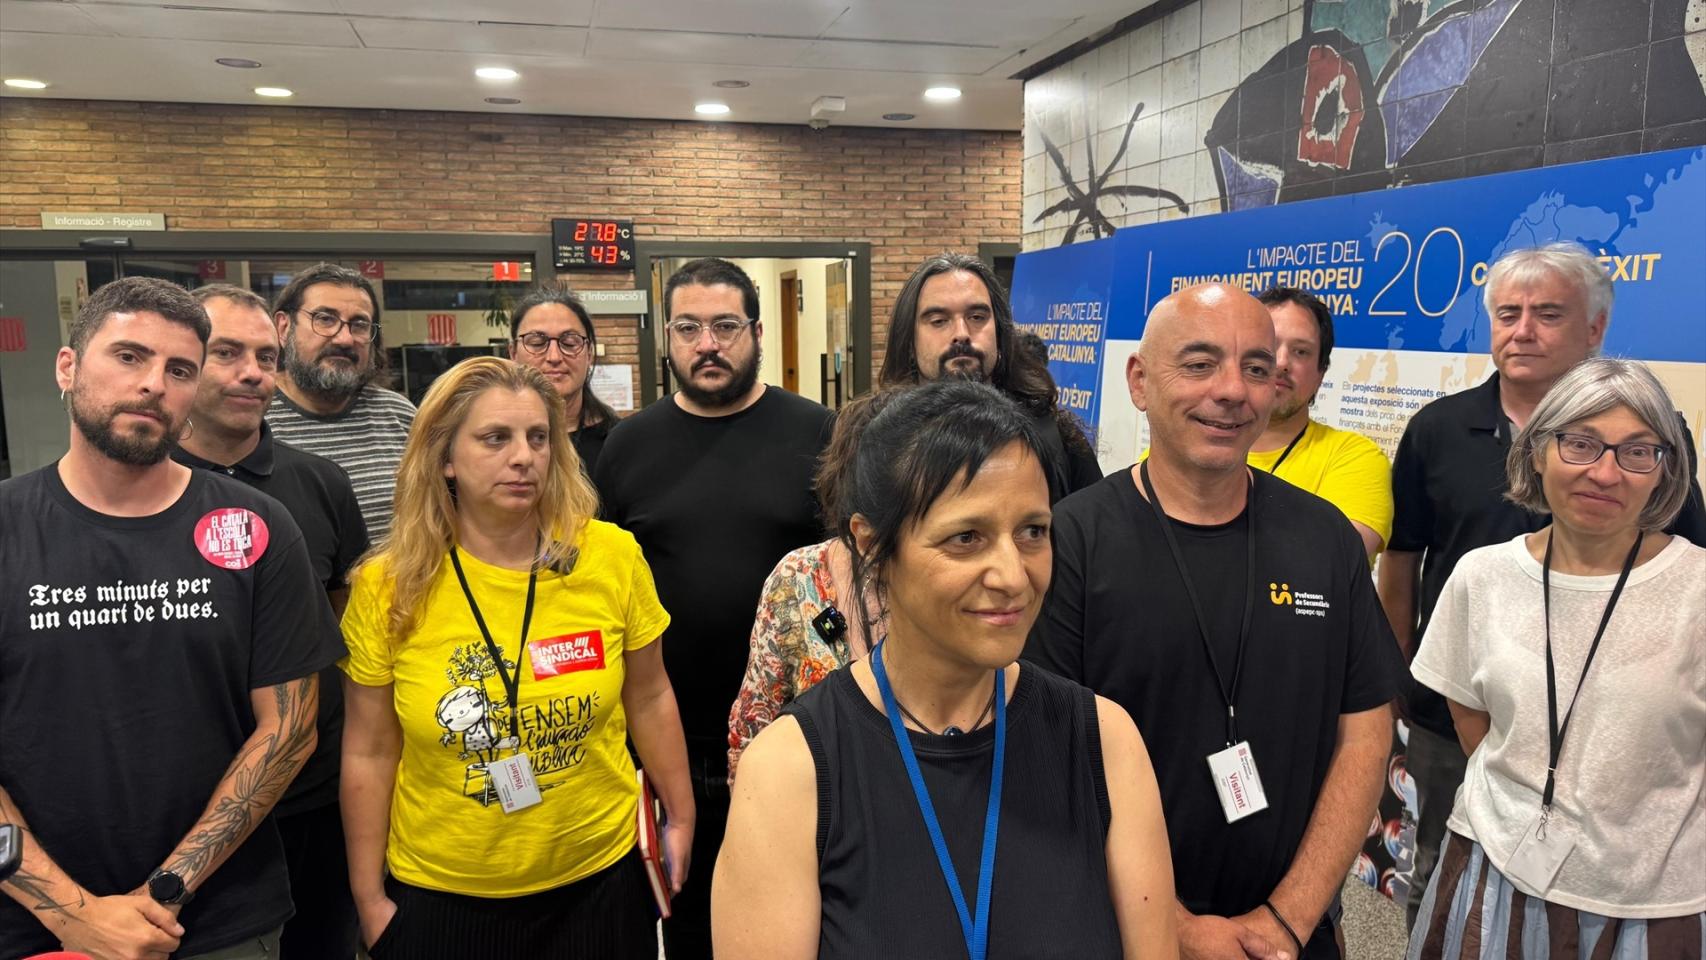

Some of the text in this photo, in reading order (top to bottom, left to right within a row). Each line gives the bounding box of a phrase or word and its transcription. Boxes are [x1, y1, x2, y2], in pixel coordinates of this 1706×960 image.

[54, 216, 105, 226] Informació
[112, 216, 152, 228] Registre
[591, 246, 618, 264] 43
[620, 250, 631, 261] %
[1247, 240, 1365, 269] L'IMPACTE DEL
[207, 260, 218, 273] 3
[367, 260, 377, 273] 2
[501, 261, 509, 275] 1
[1368, 227, 1464, 317] 20
[1277, 267, 1362, 290] EUROPEU
[1047, 302, 1103, 321] L'IMPACTE DEL
[1060, 323, 1101, 342] EUROPEU
[1061, 383, 1093, 410] D'ÈXIT
[1352, 383, 1385, 393] projectes
[1387, 385, 1434, 398] seleccionats
[1340, 406, 1364, 416] mostra
[1341, 394, 1368, 404] aquesta
[1370, 397, 1404, 408] exposició
[1405, 402, 1420, 410] són
[211, 515, 219, 529] EL
[205, 527, 212, 541] A
[208, 534, 253, 553] NO ES TOCA
[28, 577, 211, 606] Tres minuts per
[29, 598, 219, 631] un quart de dues.
[536, 641, 575, 656] INTER
[539, 647, 598, 666] SINDICAL
[1229, 772, 1246, 809] Visitant
